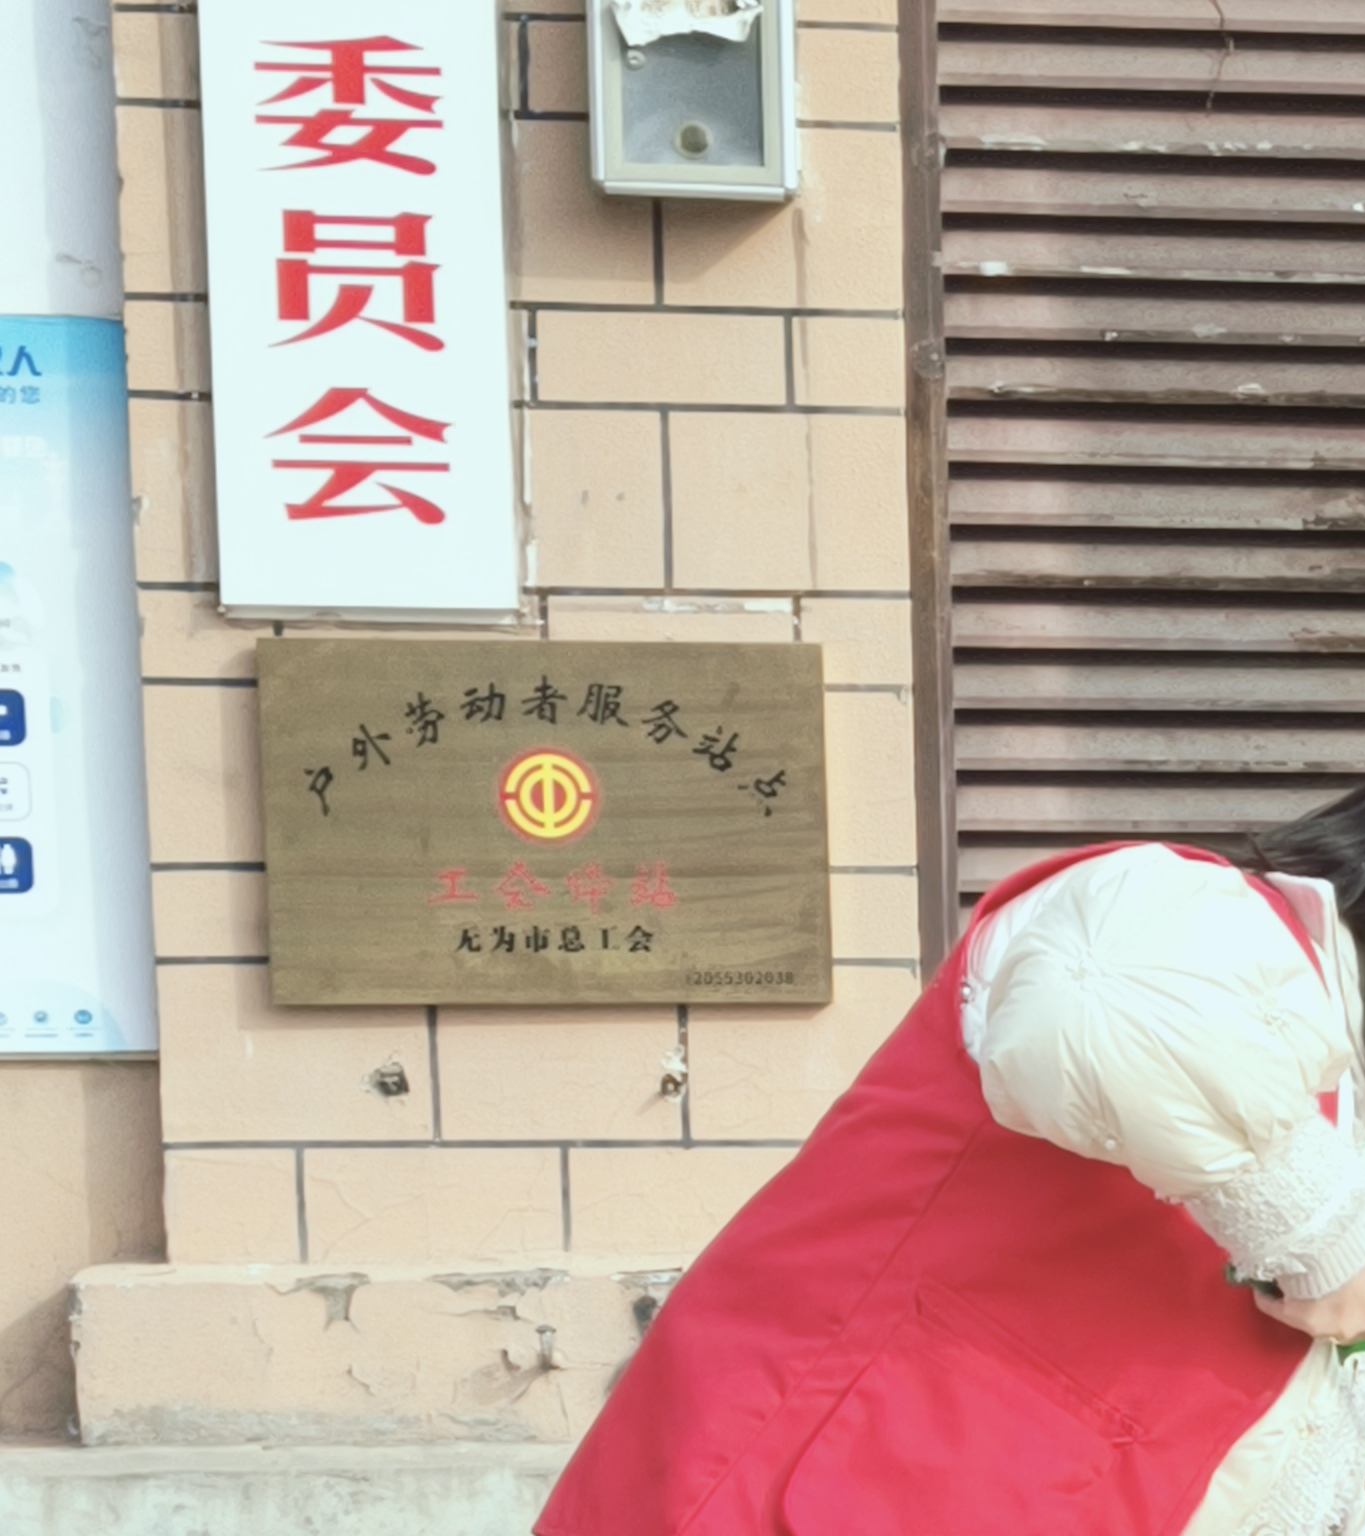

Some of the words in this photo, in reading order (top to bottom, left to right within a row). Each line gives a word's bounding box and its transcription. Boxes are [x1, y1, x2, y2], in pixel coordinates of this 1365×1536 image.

[253, 34, 453, 526] 委员会
[0, 345, 43, 377] 人
[303, 674, 788, 817] 户外劳动者服务站点
[456, 925, 655, 954] 无为市总工会
